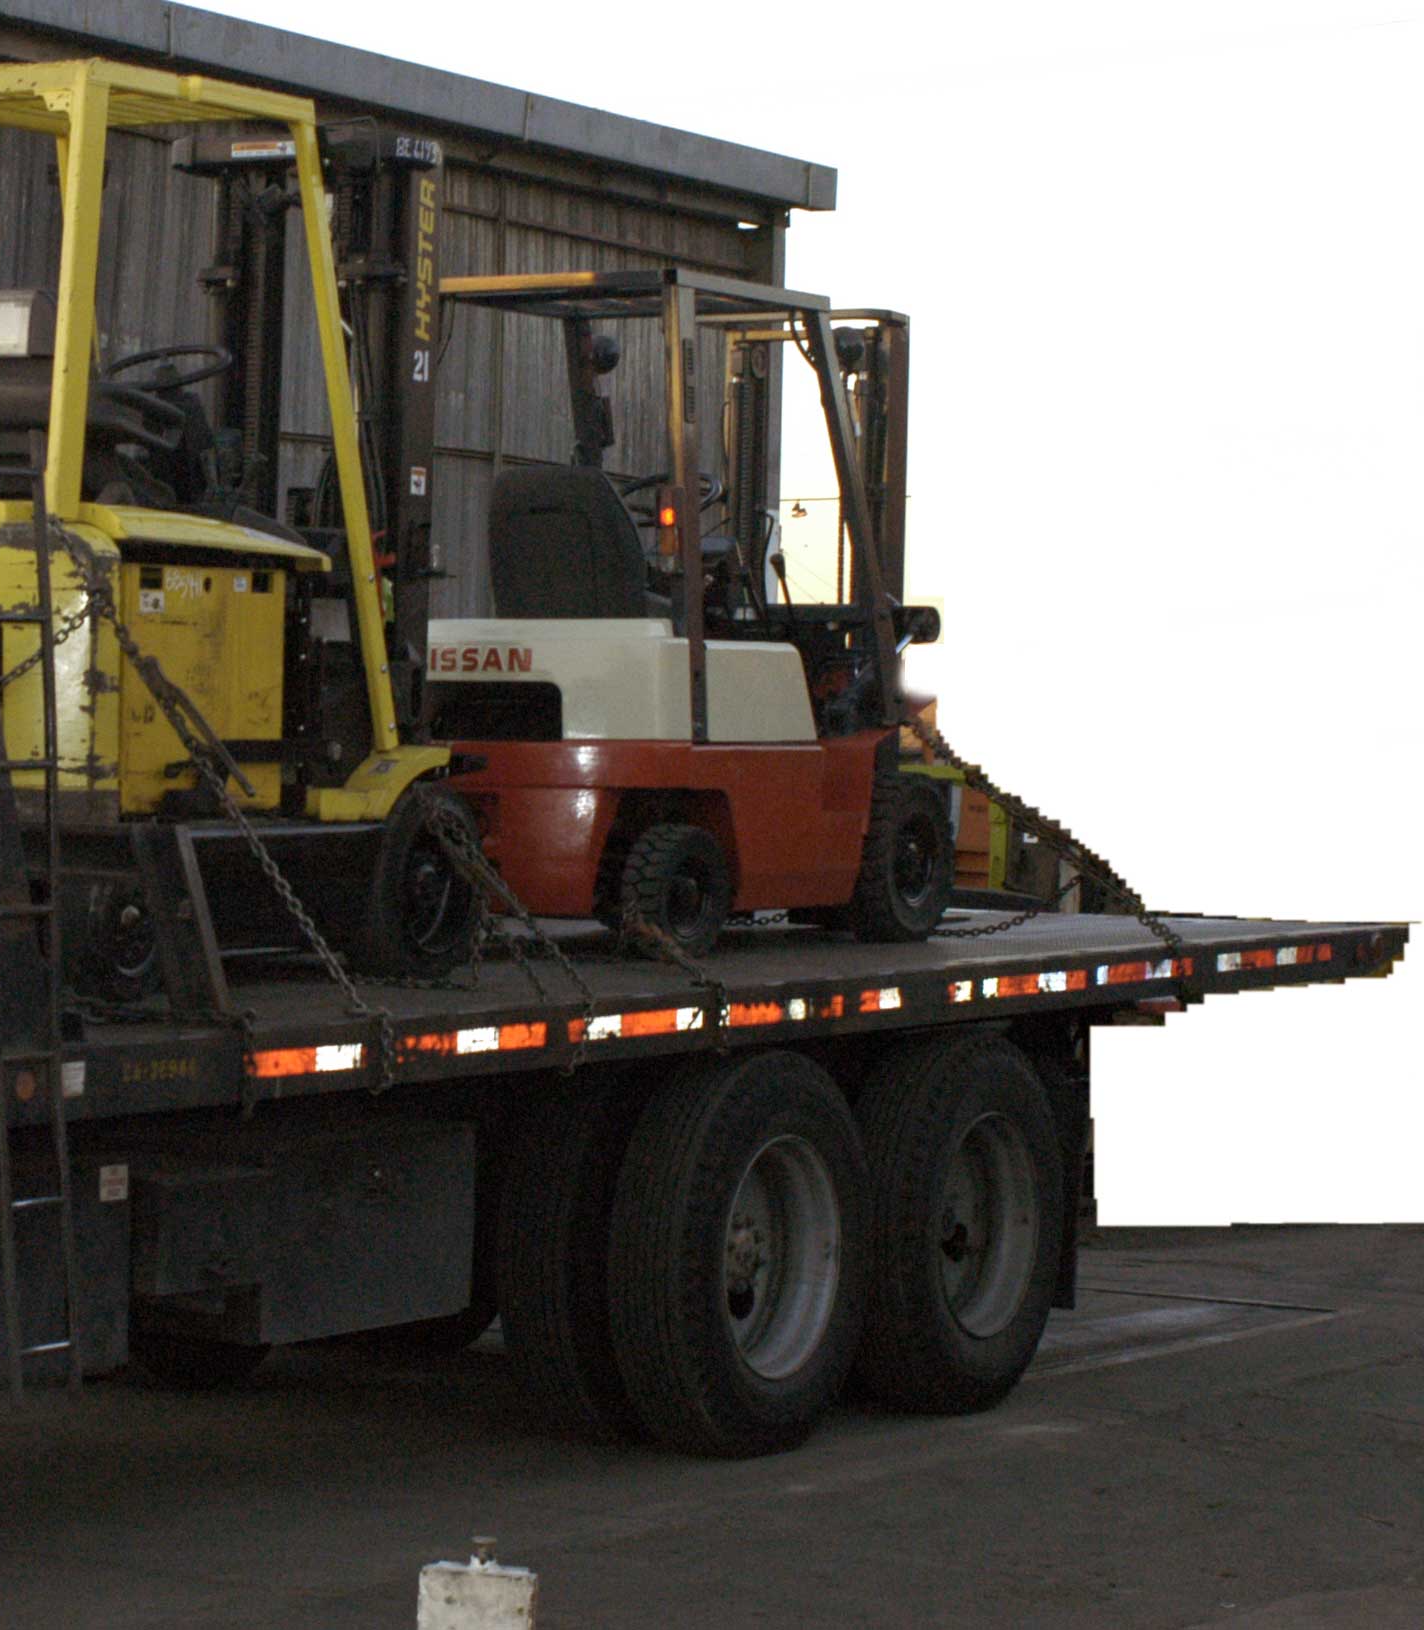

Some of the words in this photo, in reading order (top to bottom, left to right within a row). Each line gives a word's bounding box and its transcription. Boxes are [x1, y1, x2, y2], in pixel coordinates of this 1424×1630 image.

[415, 178, 436, 341] HYSTER
[413, 351, 429, 382] 21
[430, 647, 533, 672] ISSAN
